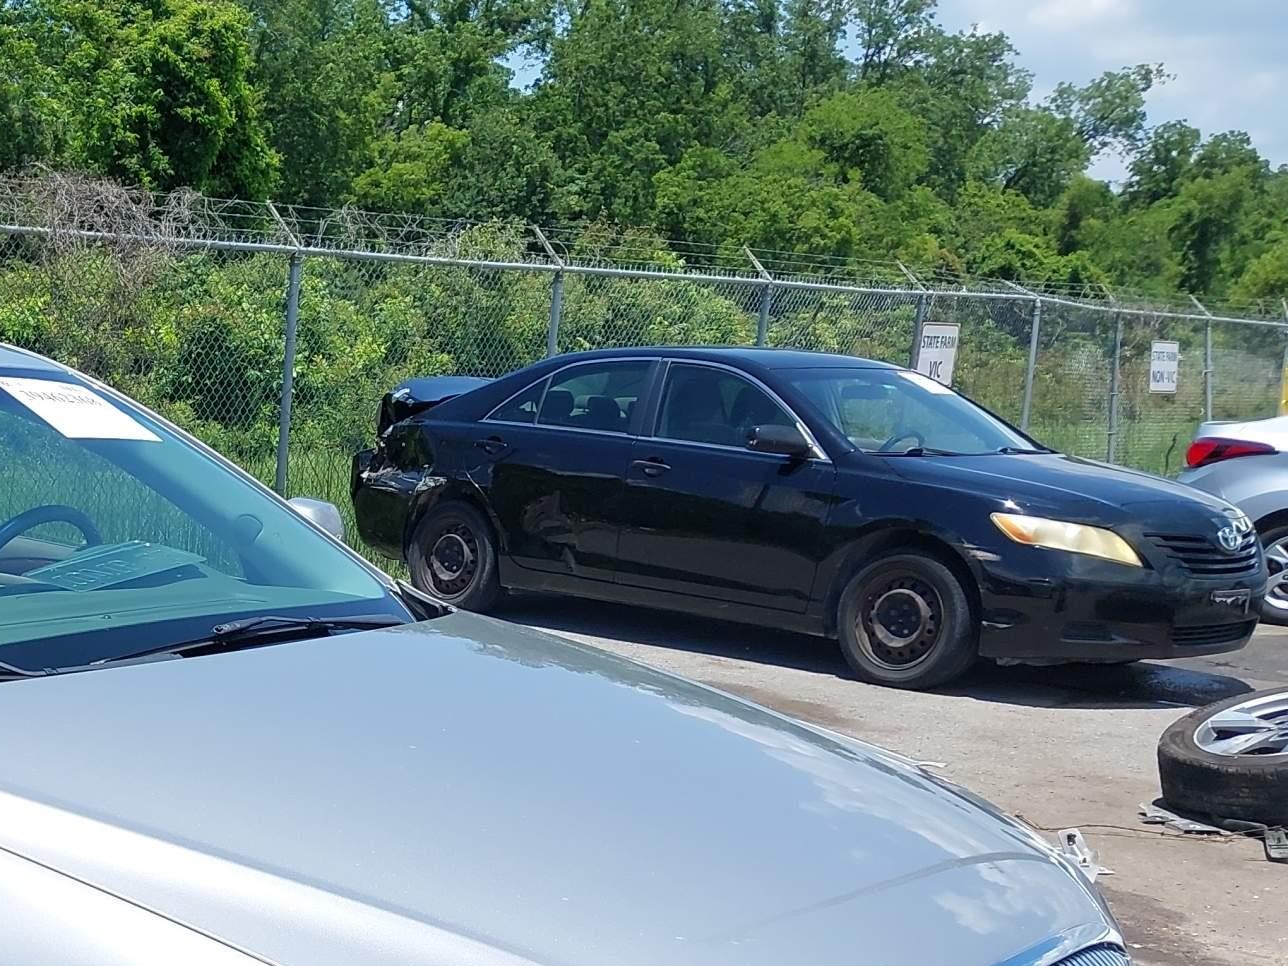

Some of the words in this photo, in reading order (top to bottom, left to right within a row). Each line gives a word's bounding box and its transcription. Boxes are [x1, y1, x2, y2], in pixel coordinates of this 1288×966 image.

[922, 335, 940, 349] STATE
[940, 335, 957, 349] FARM
[929, 360, 943, 378] VIC
